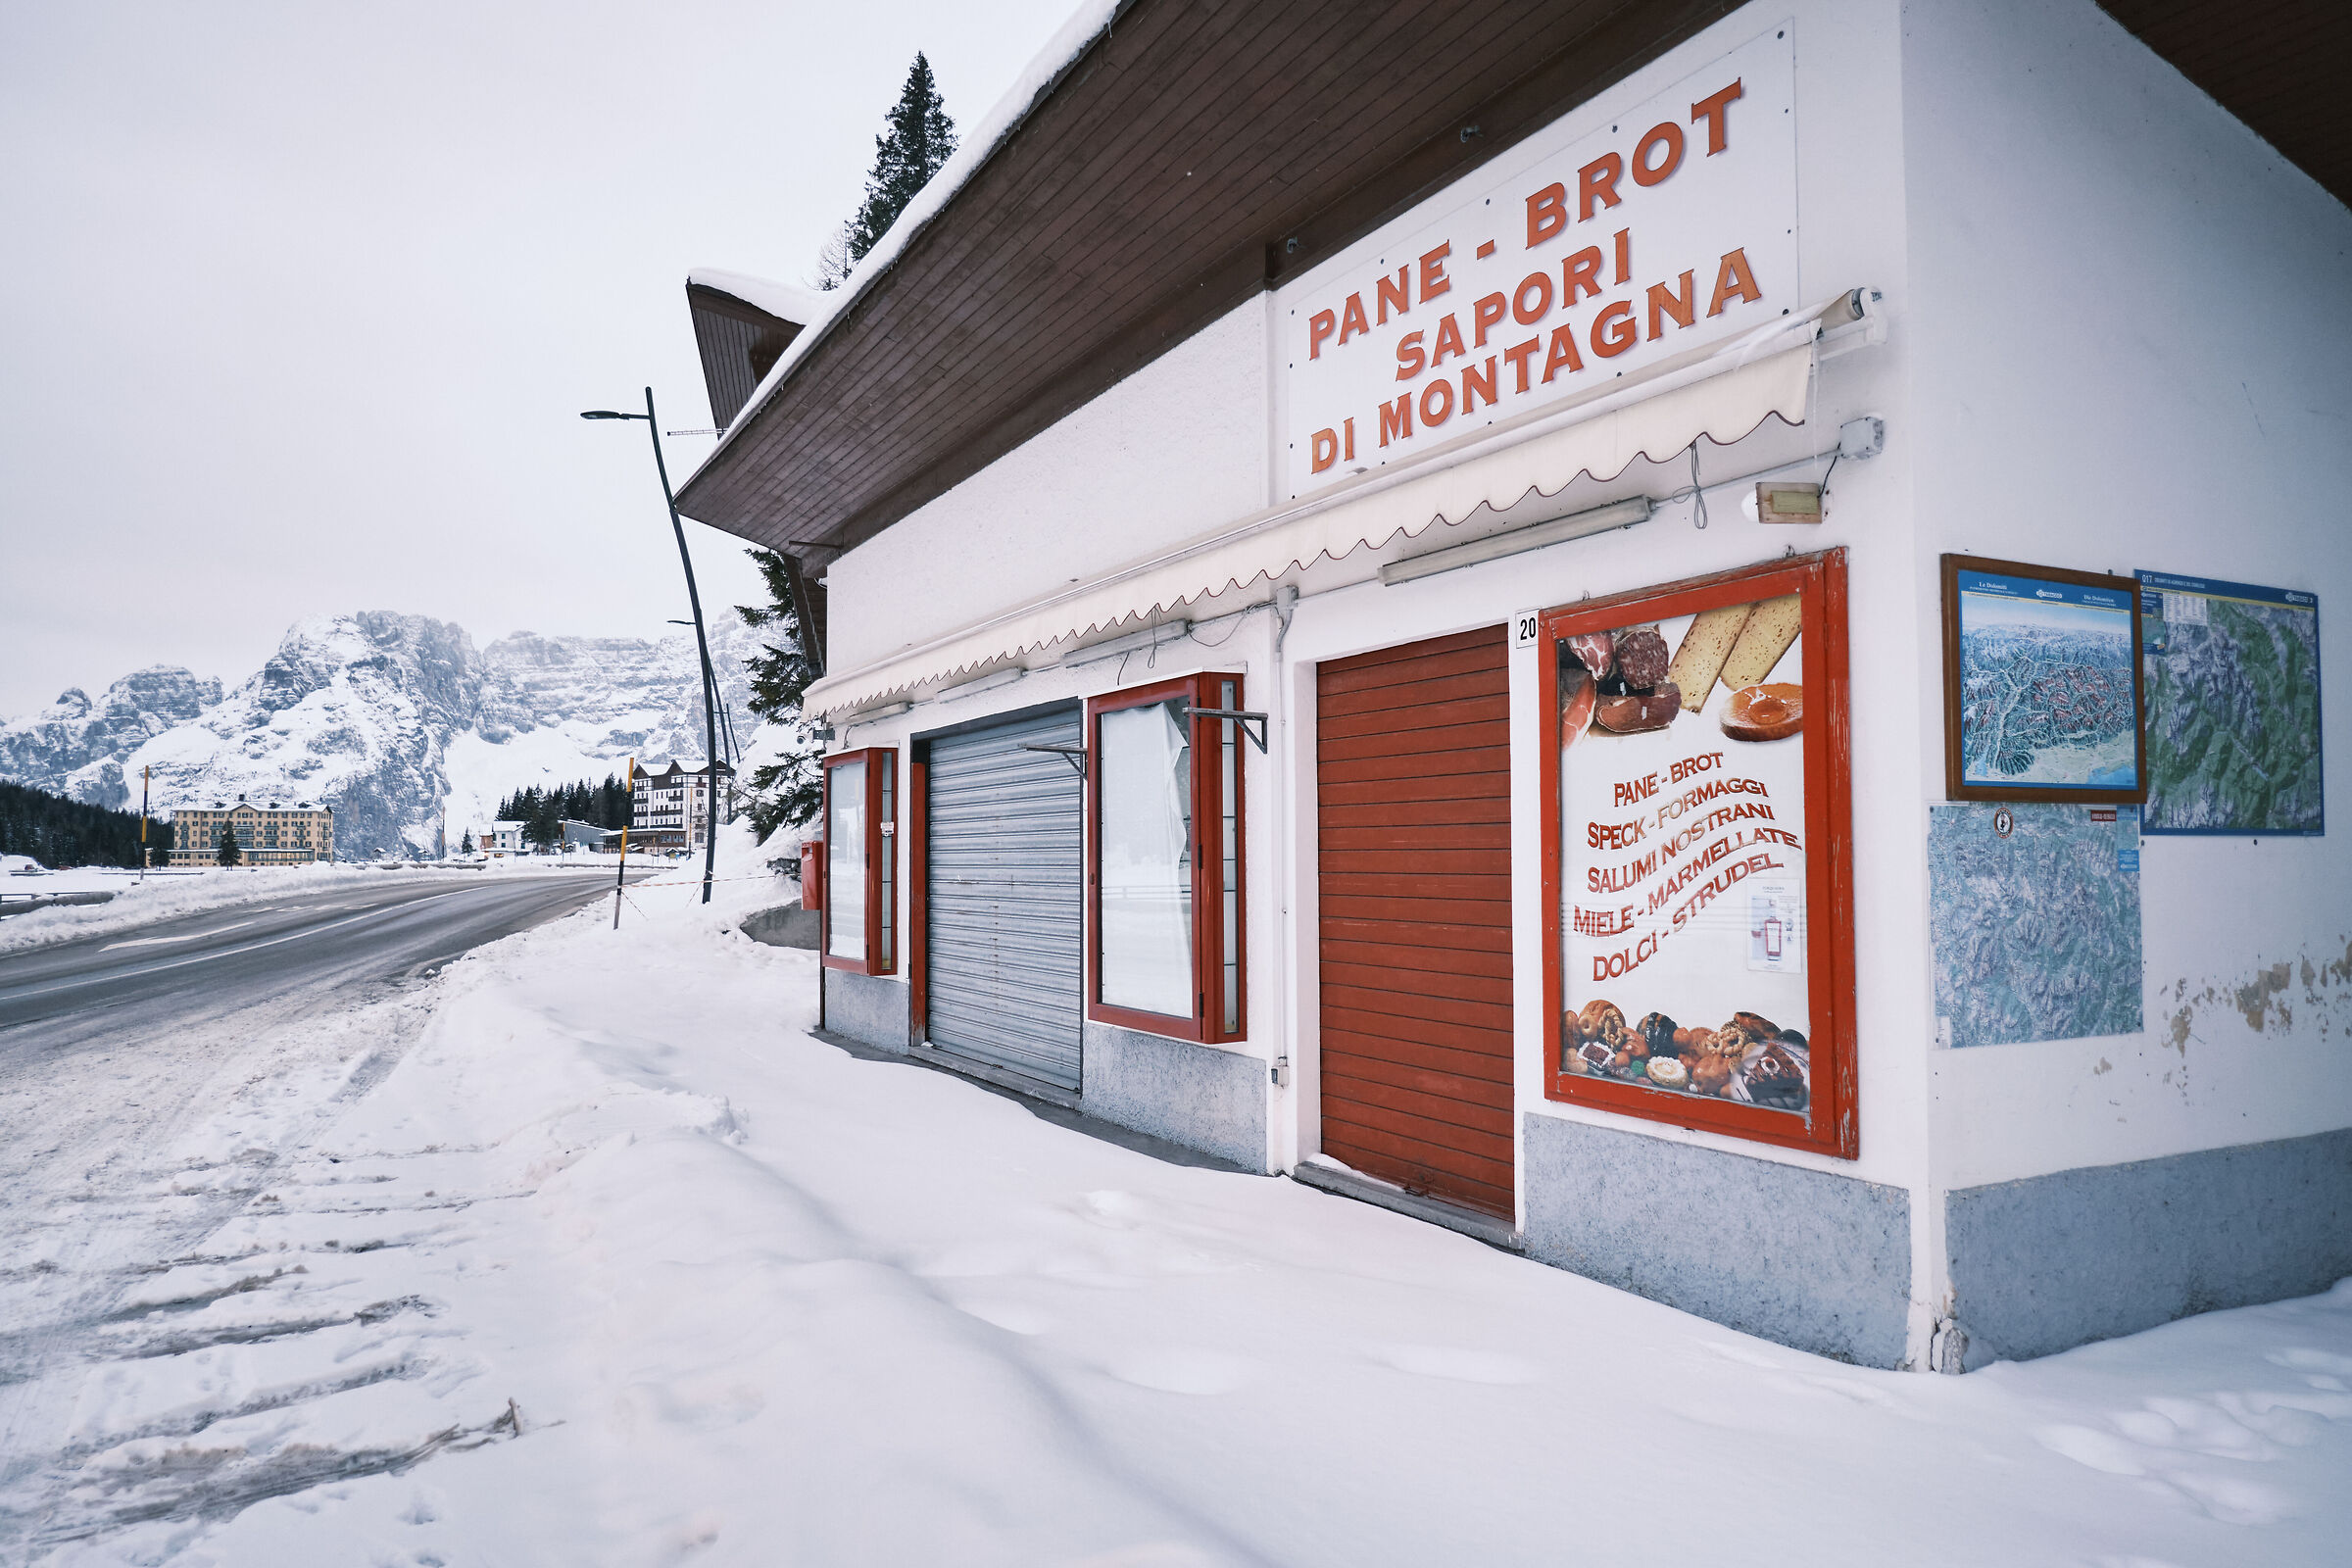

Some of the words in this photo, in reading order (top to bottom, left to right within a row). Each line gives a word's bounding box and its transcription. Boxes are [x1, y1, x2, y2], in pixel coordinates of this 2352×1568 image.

[1309, 240, 1450, 361] PANE
[1477, 239, 1494, 260] -
[1526, 77, 1741, 250] BROT
[1396, 227, 1631, 381] SAPORI
[1311, 417, 1354, 474] DI
[1379, 247, 1762, 448] MONTAGNA
[1520, 617, 1536, 640] 20
[1588, 816, 1647, 851] SPECK
[1657, 777, 1769, 829] FORMAGGI
[1614, 771, 1659, 808] PANE
[1670, 752, 1724, 784] BROT
[1573, 903, 1635, 938] MIELE
[1648, 826, 1802, 915] MARMELLATE
[1588, 849, 1657, 894] SALUMI
[1662, 803, 1775, 865] NOSTRANI
[1592, 929, 1658, 982] DOLCI
[1672, 853, 1785, 933] STRUDEL
